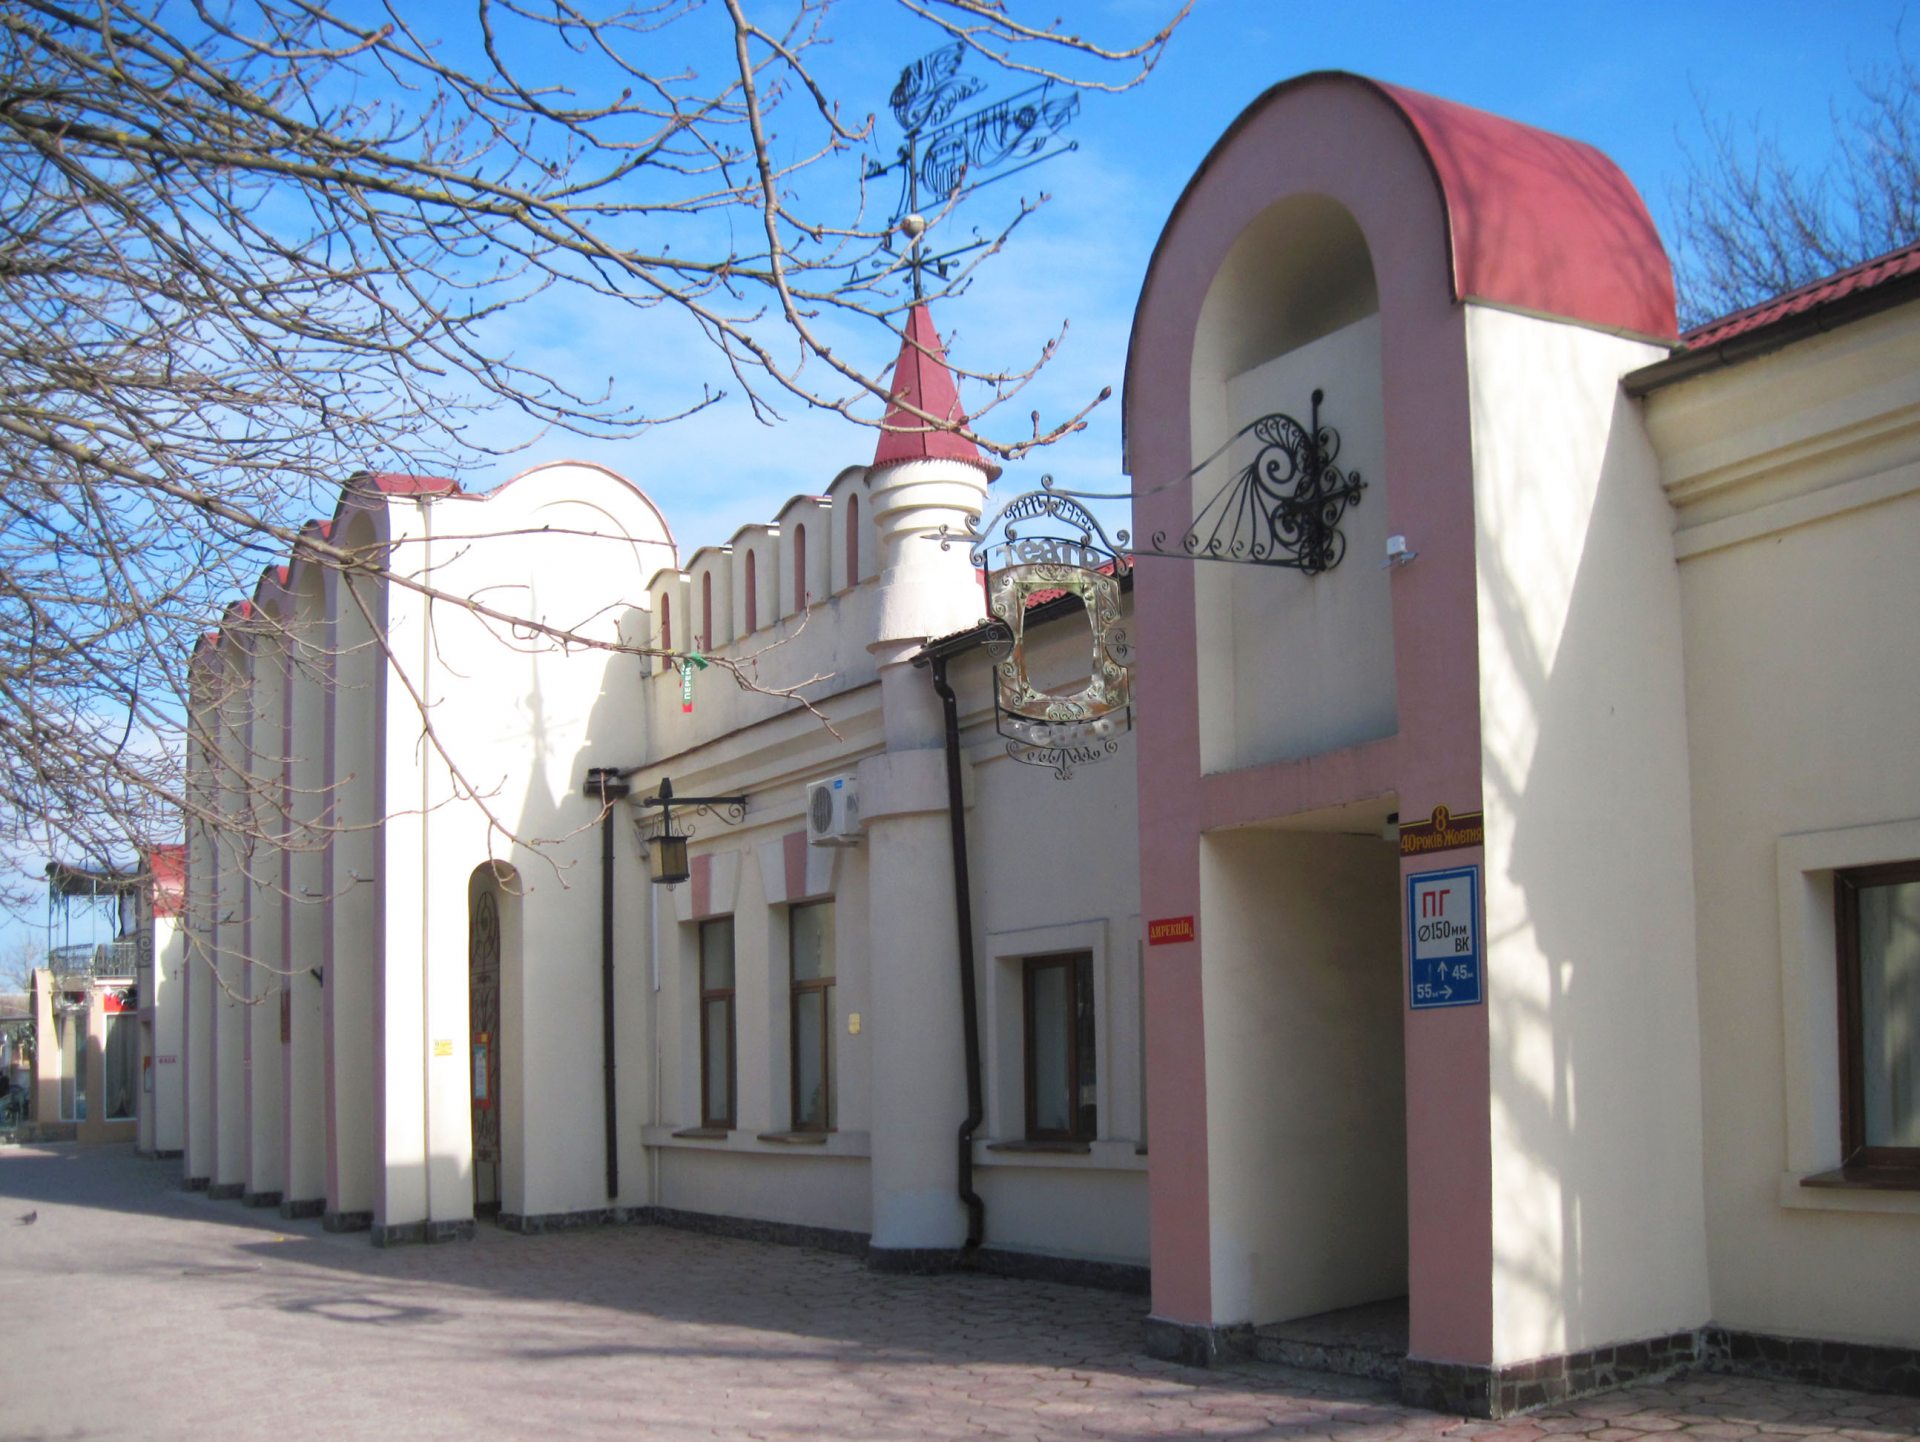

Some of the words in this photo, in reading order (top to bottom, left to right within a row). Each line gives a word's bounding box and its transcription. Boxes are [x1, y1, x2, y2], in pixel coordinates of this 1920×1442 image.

[1435, 807, 1447, 832] 8
[1401, 834, 1416, 853] 40
[1423, 889, 1450, 918] ПГ
[1150, 919, 1189, 938] ДИРЕКЦІЯ
[1455, 937, 1470, 952] ВК
